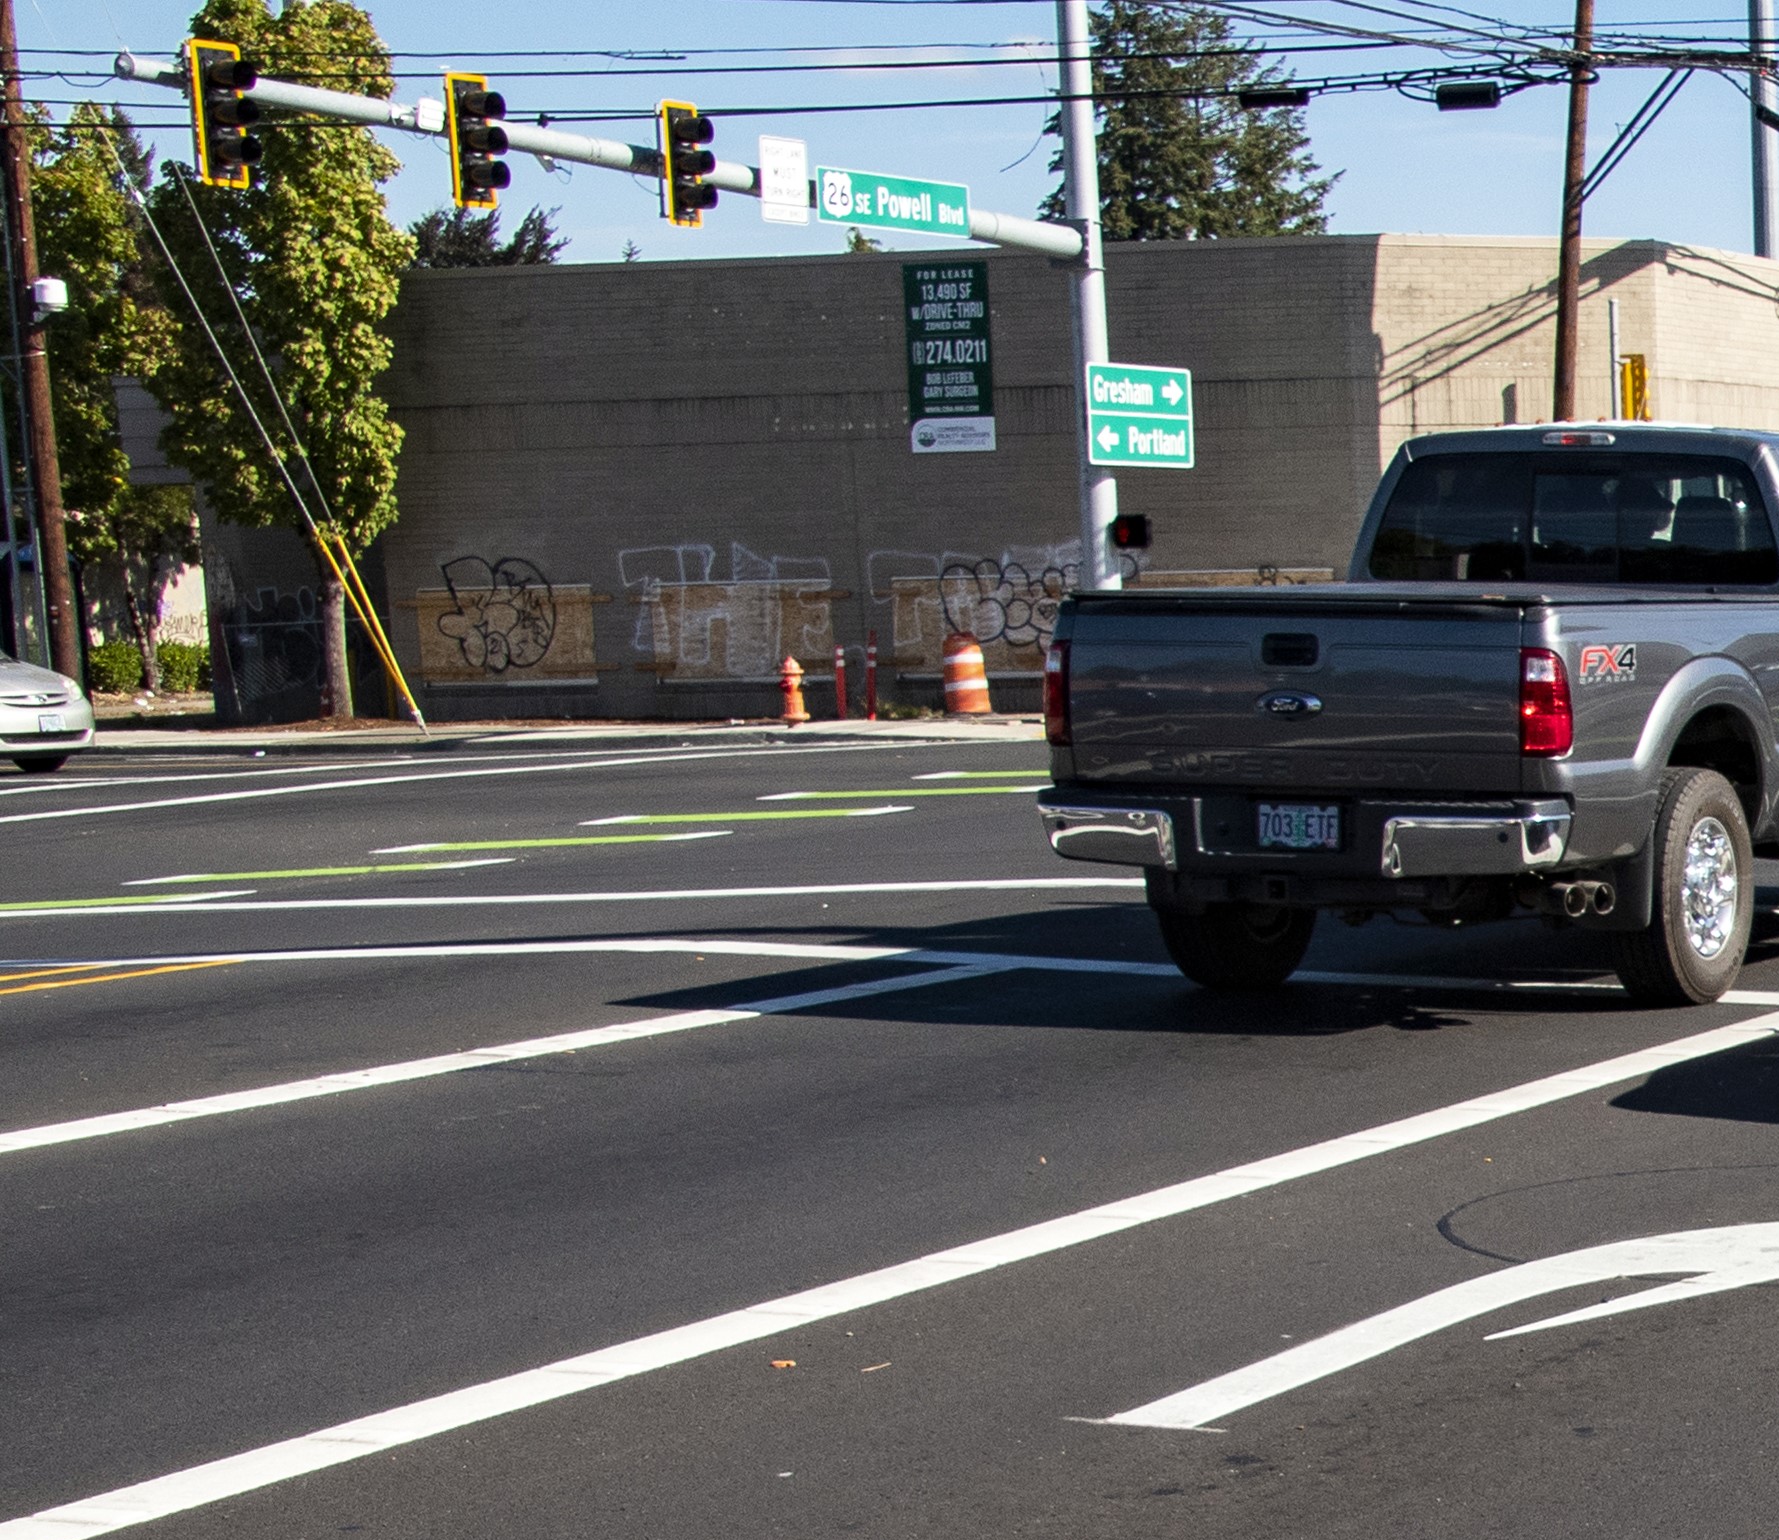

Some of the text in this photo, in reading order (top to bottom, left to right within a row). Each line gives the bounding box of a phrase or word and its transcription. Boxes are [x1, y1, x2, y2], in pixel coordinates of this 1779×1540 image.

[828, 182, 964, 226] 26 SE Powell Blvd
[917, 269, 974, 280] FOR LEASE
[922, 282, 973, 301] 13,490 SF
[1093, 374, 1153, 406] Gresham
[1128, 425, 1186, 457] Portland
[1579, 644, 1637, 676] FX4
[1271, 698, 1299, 712] Ford
[1151, 752, 1441, 782] SUPER DUTY
[1261, 812, 1337, 839] 703 ETF
